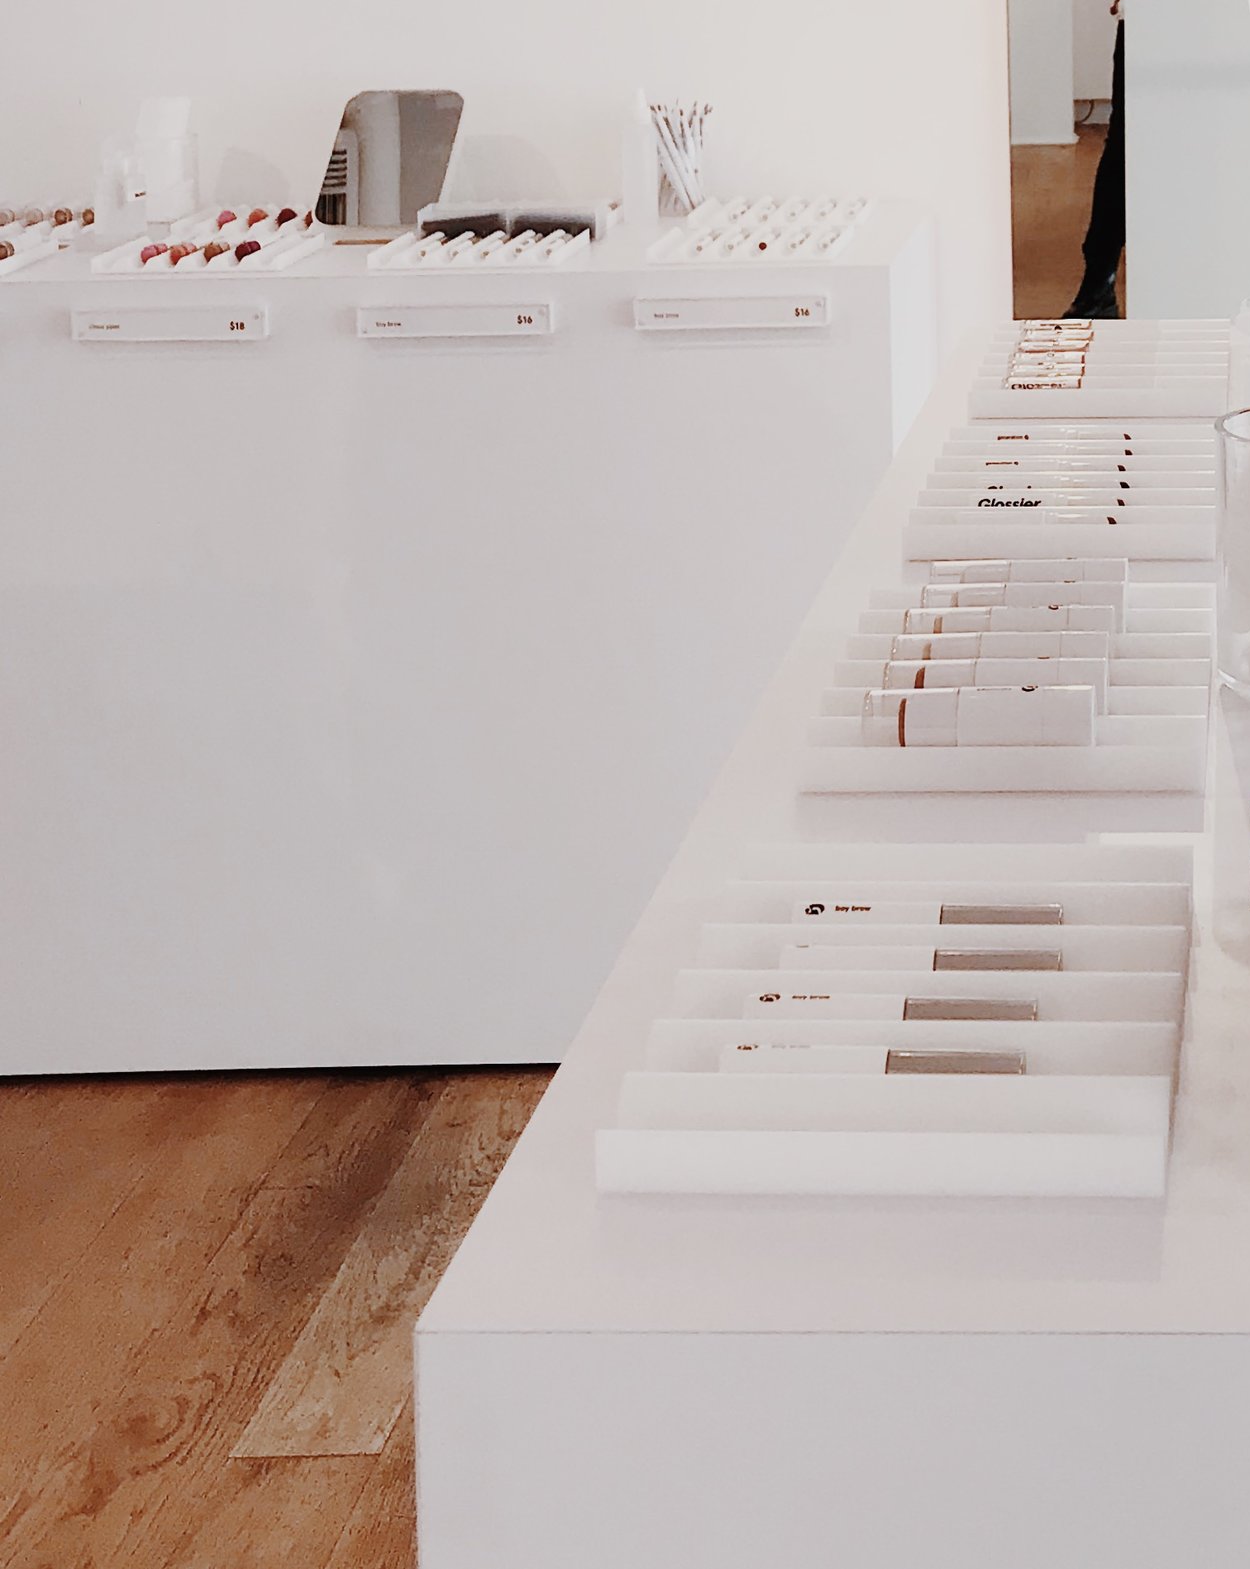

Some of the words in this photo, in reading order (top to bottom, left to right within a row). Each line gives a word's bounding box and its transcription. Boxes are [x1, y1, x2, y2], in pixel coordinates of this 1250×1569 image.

[794, 308, 810, 318] $16
[517, 314, 533, 324] $16
[229, 321, 246, 331] $18
